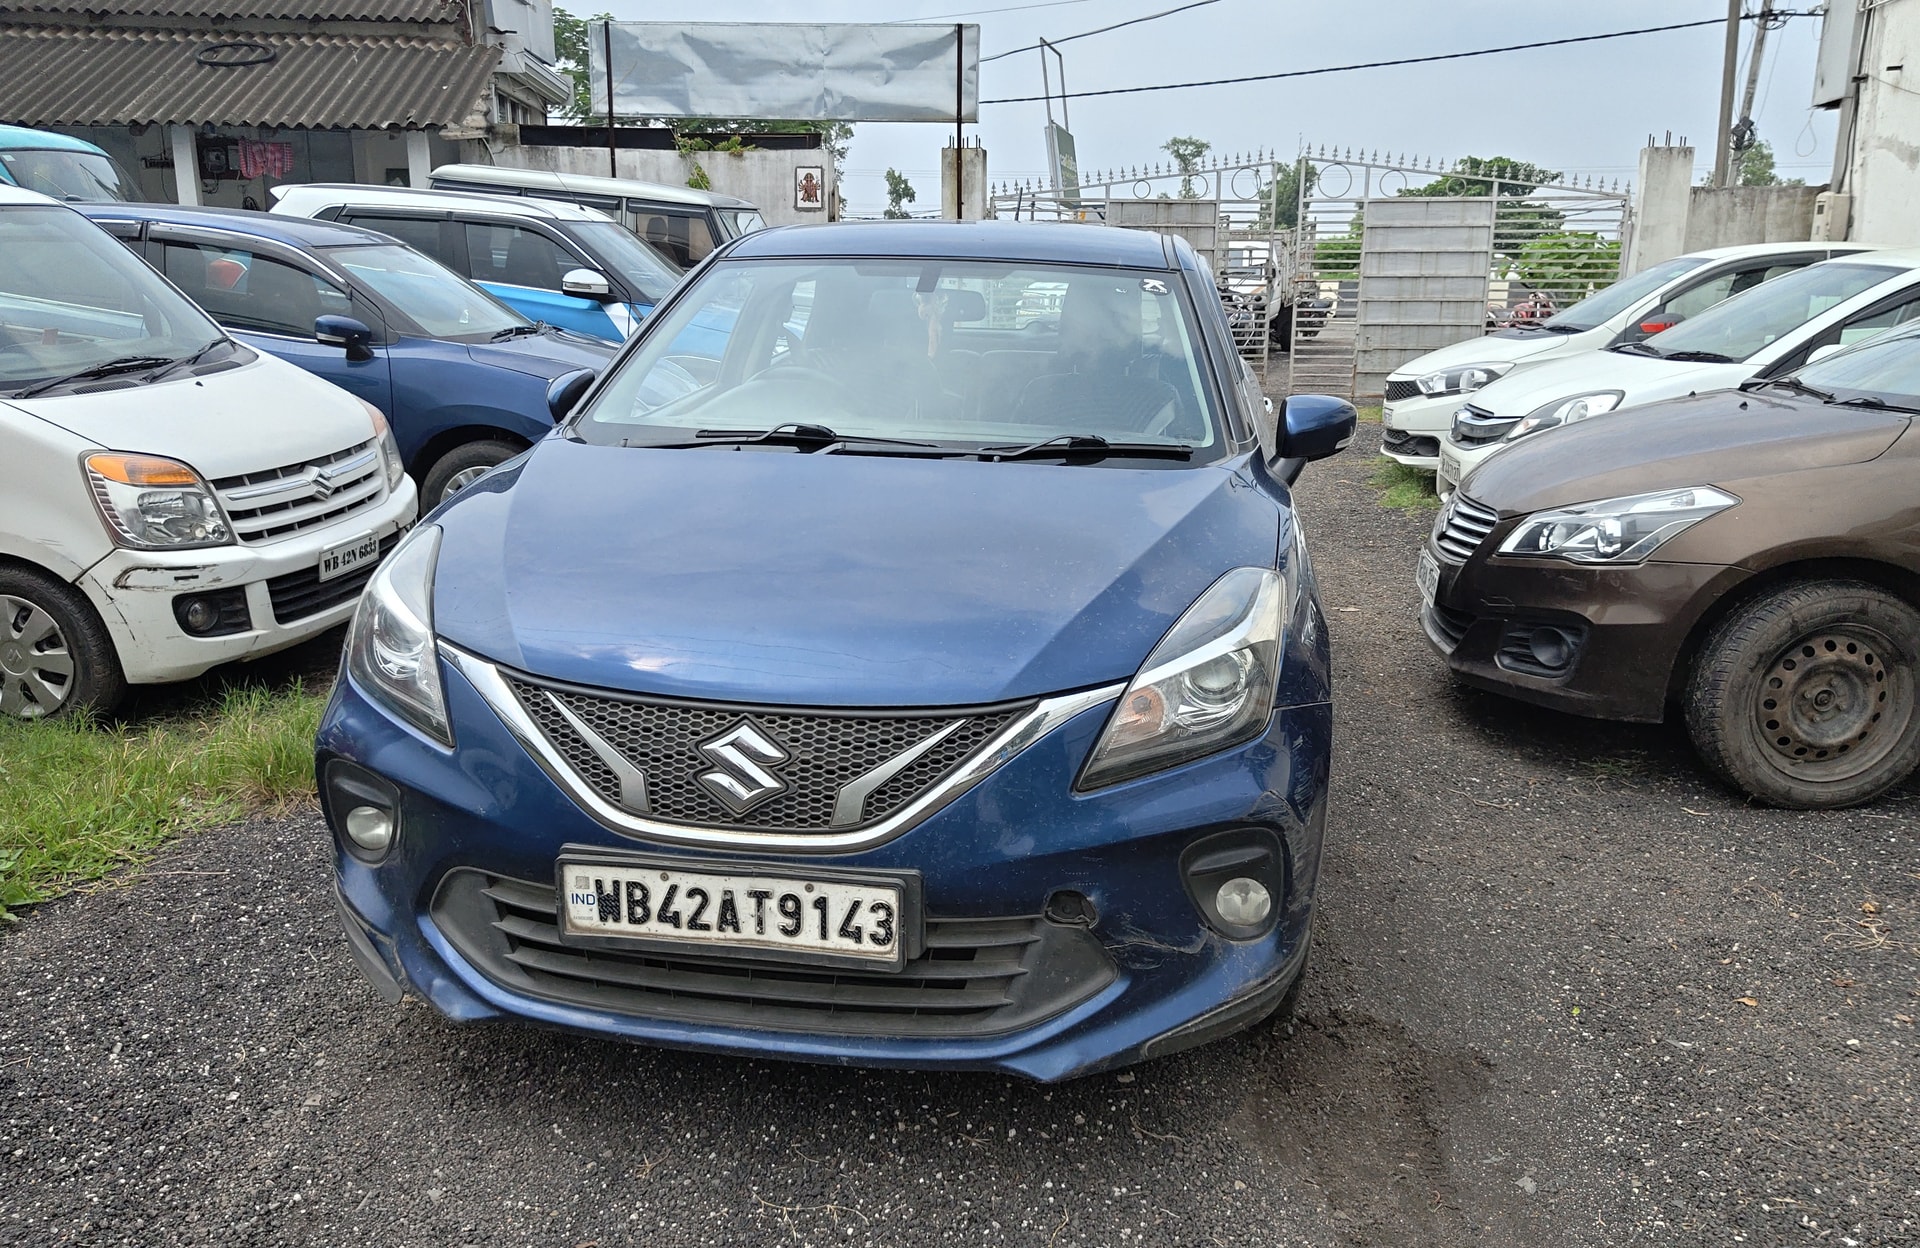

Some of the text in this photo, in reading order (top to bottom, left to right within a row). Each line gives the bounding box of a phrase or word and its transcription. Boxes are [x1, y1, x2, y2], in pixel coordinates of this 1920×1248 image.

[324, 555, 339, 573] WB
[341, 548, 357, 566] 42N
[571, 893, 595, 905] IND
[594, 878, 895, 946] WB42AT9143
